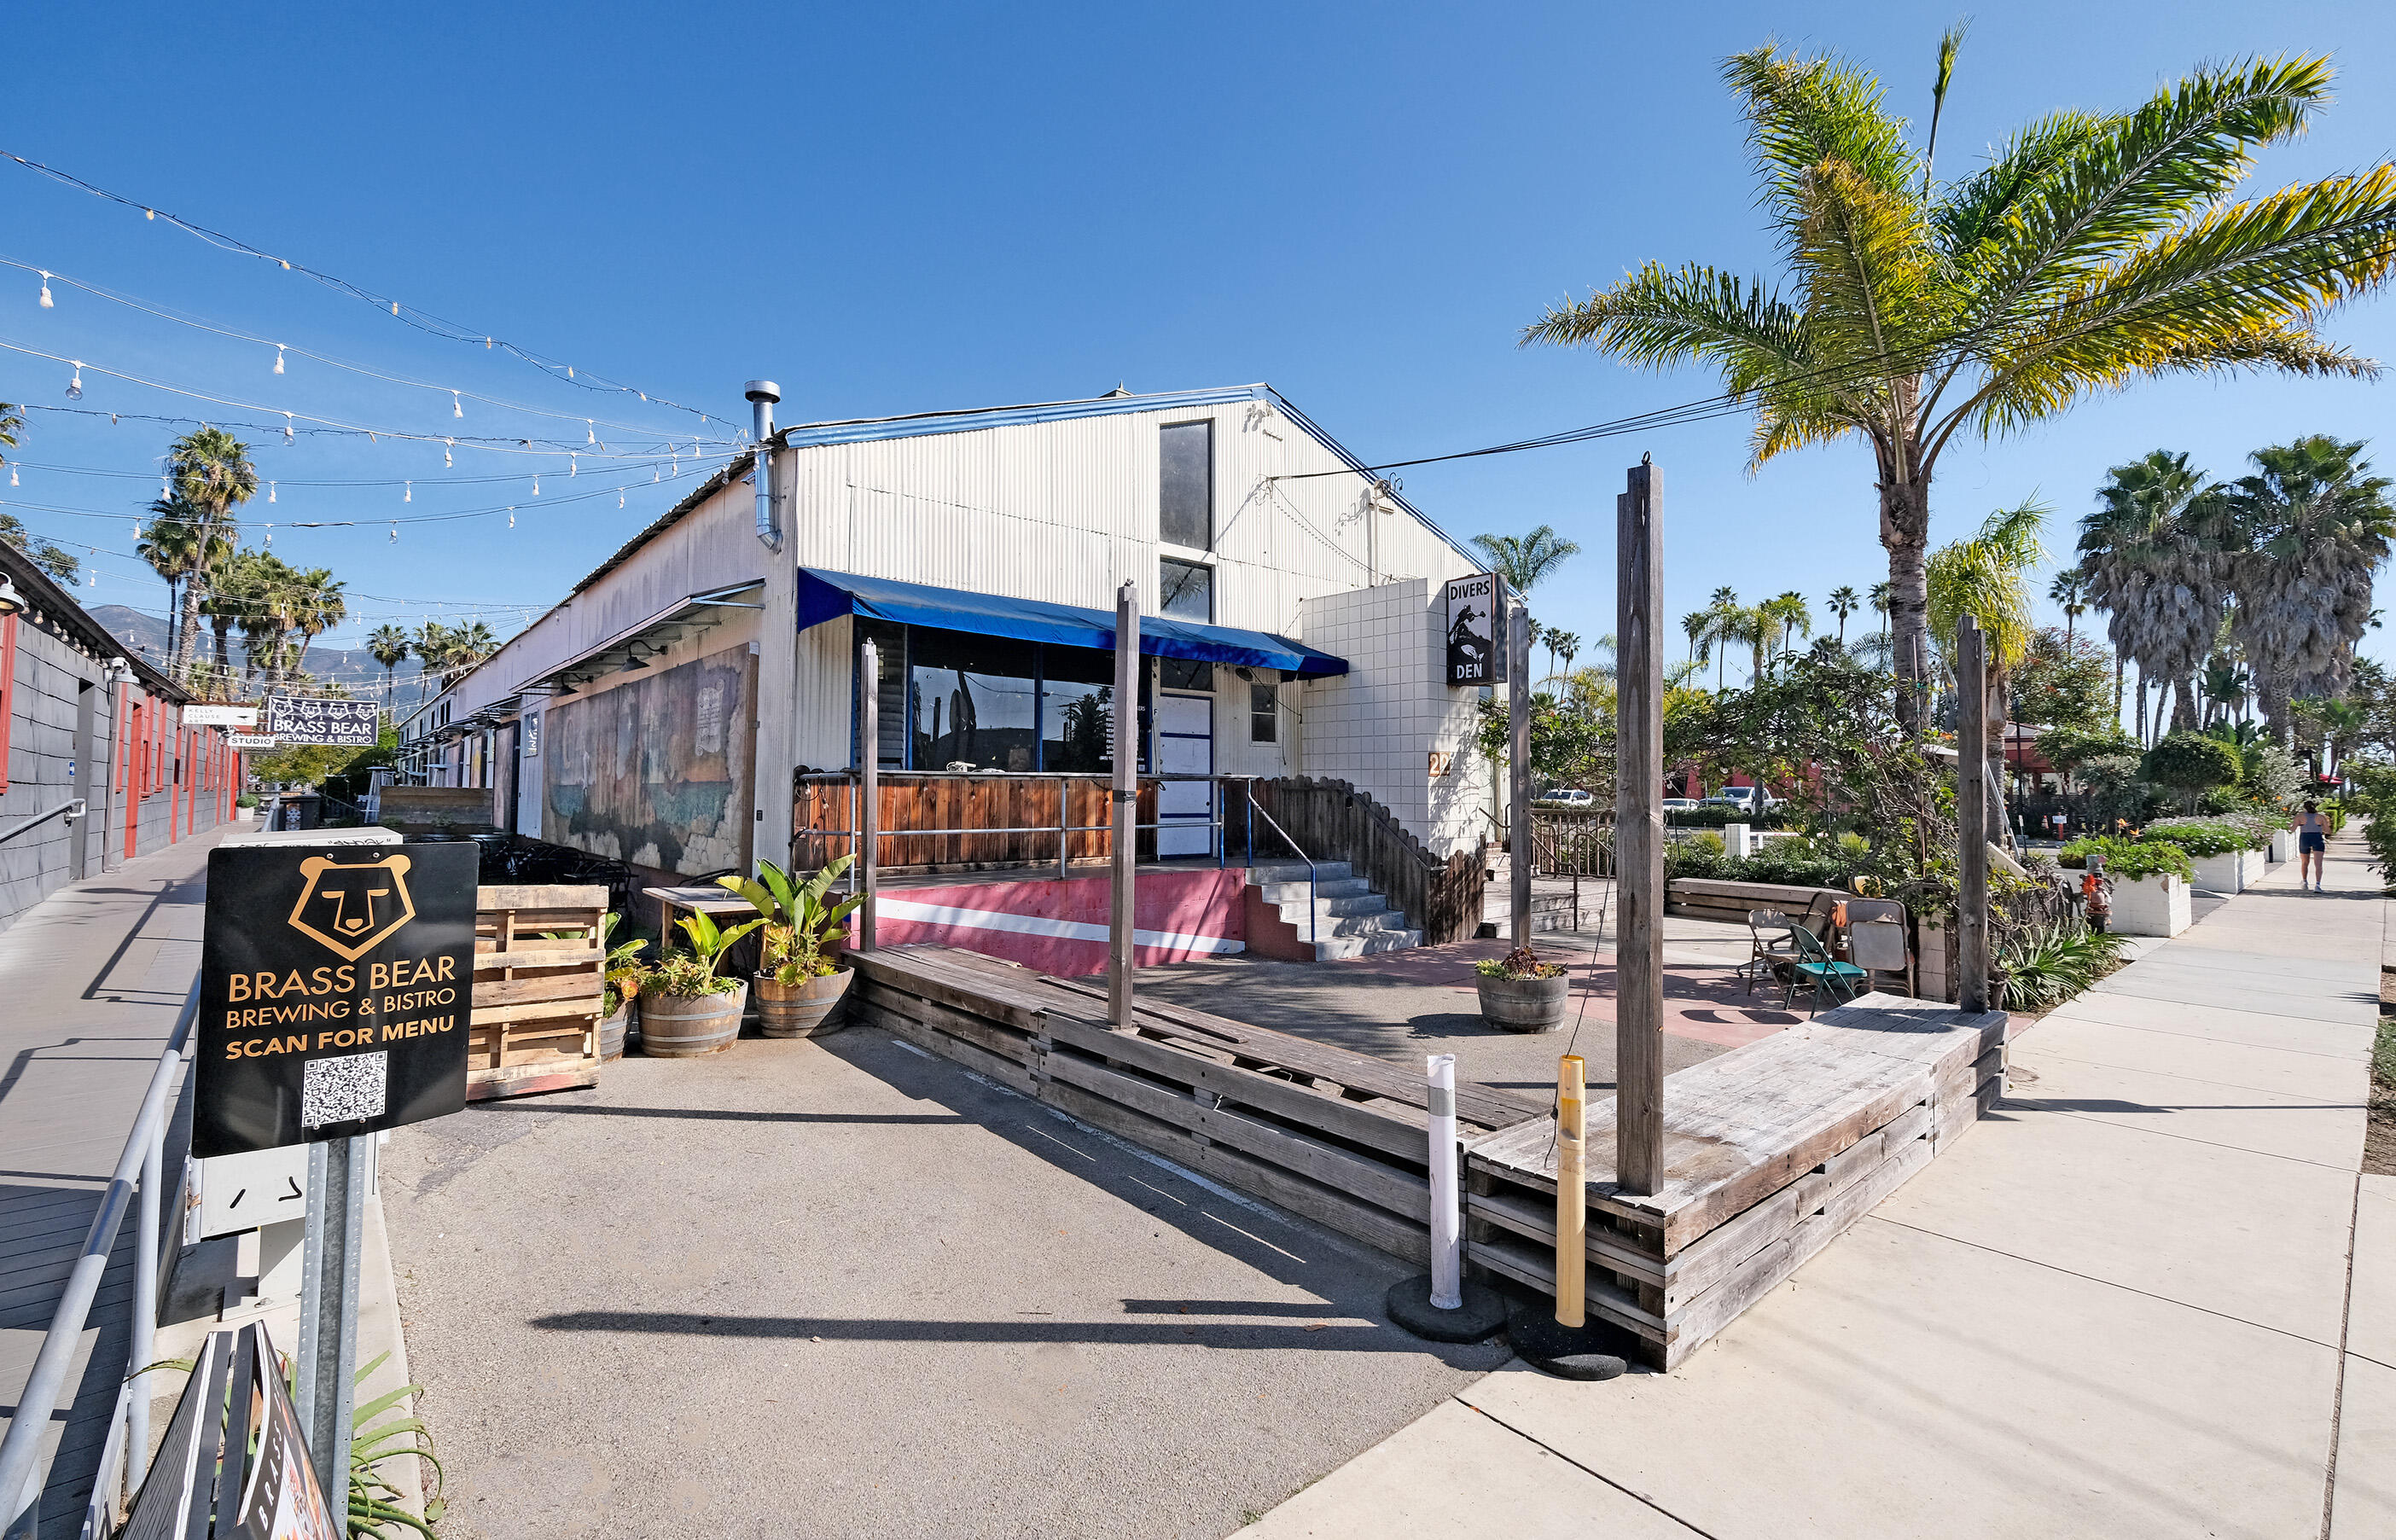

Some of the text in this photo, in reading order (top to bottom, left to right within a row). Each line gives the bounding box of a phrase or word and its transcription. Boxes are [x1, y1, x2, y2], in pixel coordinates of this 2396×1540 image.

[1450, 580, 1491, 601] DIVERS
[1457, 664, 1482, 679] DEN
[273, 719, 372, 735] BRASS BEAR
[274, 733, 372, 744] BREWING & BISTRO
[229, 956, 456, 1002] BRASS BEAR
[226, 987, 456, 1029] BREWING & BISTRO
[225, 1014, 455, 1060] SCAN FOR MENU
